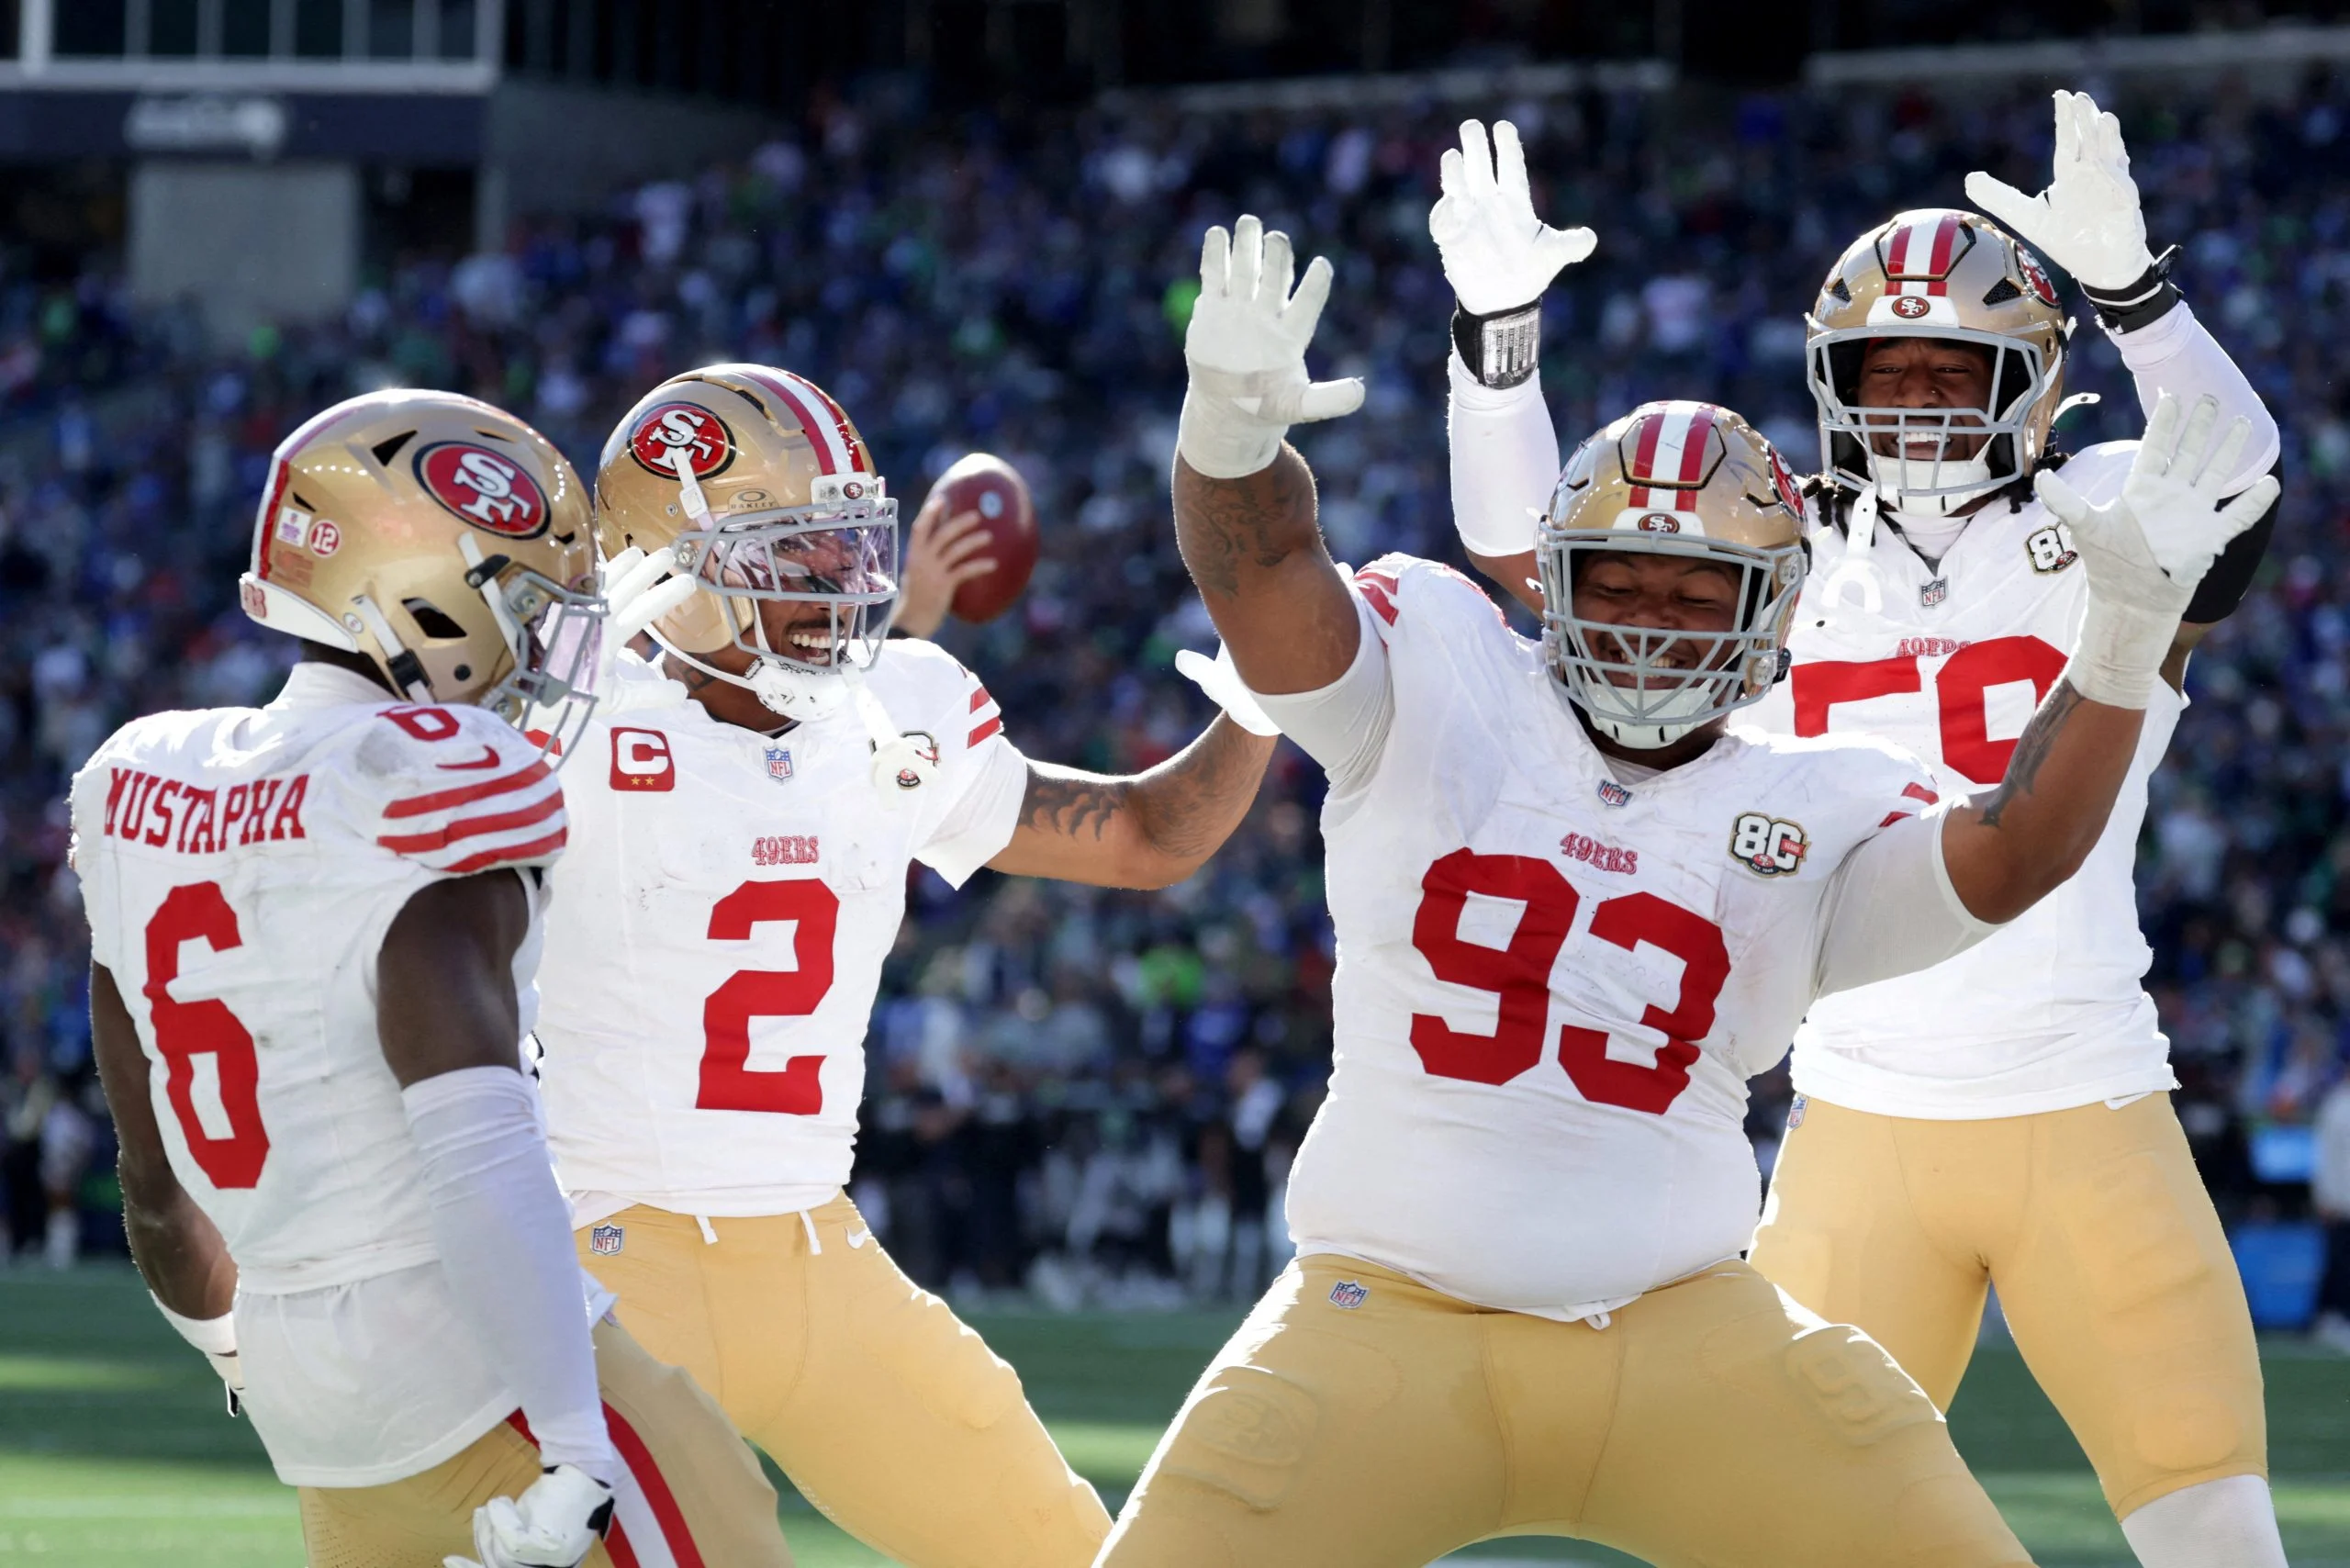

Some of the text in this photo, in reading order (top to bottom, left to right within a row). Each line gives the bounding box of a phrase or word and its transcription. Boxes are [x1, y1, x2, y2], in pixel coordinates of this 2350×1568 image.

[453, 453, 532, 523] SF
[313, 525, 333, 552] 12
[1925, 588, 1945, 604] NFL
[617, 731, 669, 775] C
[769, 760, 791, 775] NFL
[1601, 786, 1624, 803] NFL
[751, 834, 819, 866] 49ERS
[1560, 831, 1638, 875] 49ERS
[695, 878, 840, 1114] 2
[1409, 846, 1731, 1115] 93
[142, 880, 270, 1189] 6
[596, 1238, 618, 1250] NFL
[1334, 1291, 1358, 1305] NFL
